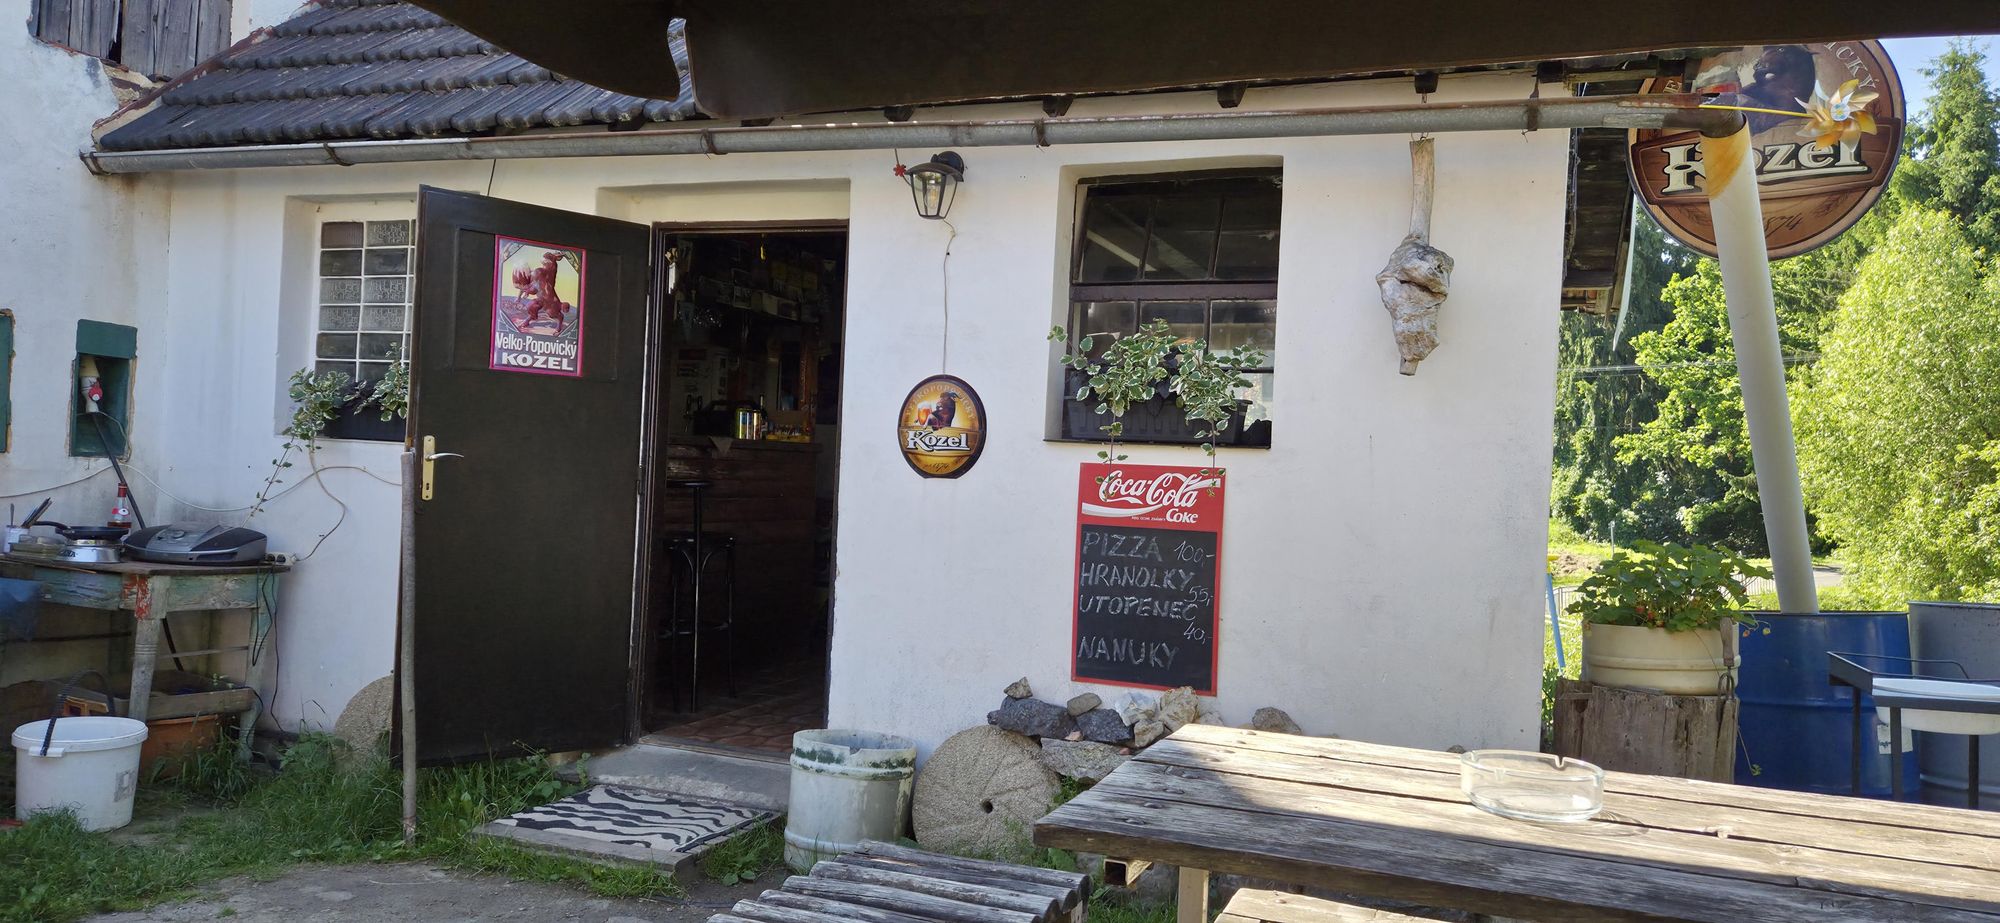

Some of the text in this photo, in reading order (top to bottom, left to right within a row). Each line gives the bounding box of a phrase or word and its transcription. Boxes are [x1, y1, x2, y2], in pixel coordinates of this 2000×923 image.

[495, 331, 577, 359] Velko-Popovický
[501, 352, 574, 371] KOZEL
[906, 430, 971, 451] Kozel
[1098, 470, 1203, 508] Coca-Cola
[1165, 508, 1199, 524] Coke
[1082, 531, 1163, 562] PIZZA
[1080, 562, 1196, 592] HRANOLKY
[1077, 635, 1180, 671] NANUKY
